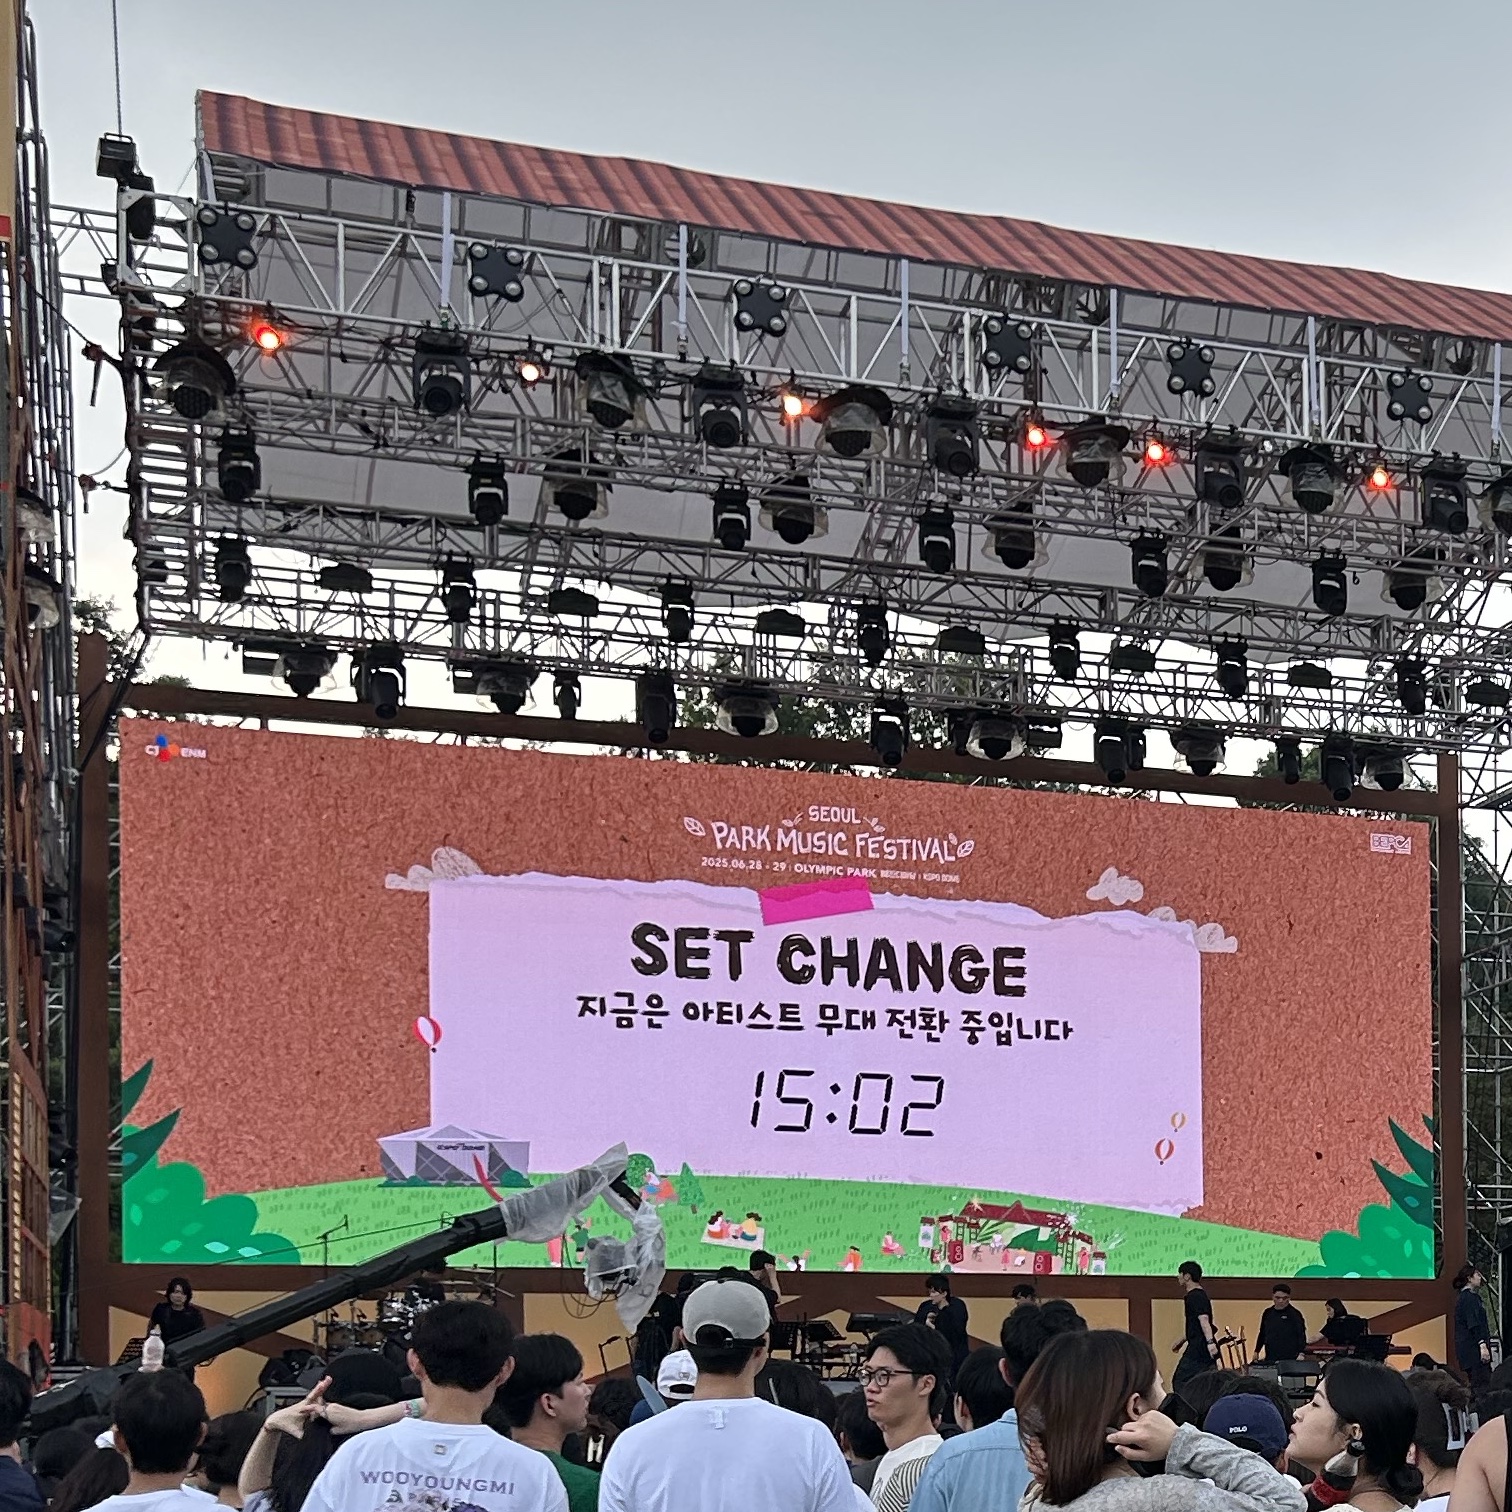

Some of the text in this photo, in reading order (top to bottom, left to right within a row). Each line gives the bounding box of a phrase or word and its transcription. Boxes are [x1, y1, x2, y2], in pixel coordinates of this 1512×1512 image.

[808, 805, 861, 824] SEOUL
[711, 821, 956, 864] PARK MUSIC FESTIVAL
[773, 861, 787, 872] 29
[794, 862, 844, 877] OLYMPIC
[847, 866, 877, 879] PARK
[631, 922, 1028, 997] SET CHANGE
[576, 991, 1075, 1046] 지금은 아티스트 무대 전환 중입니다
[750, 1069, 945, 1137] 15:02
[1229, 1425, 1248, 1434] POLO
[360, 1470, 515, 1496] WOOYOUNGMI
